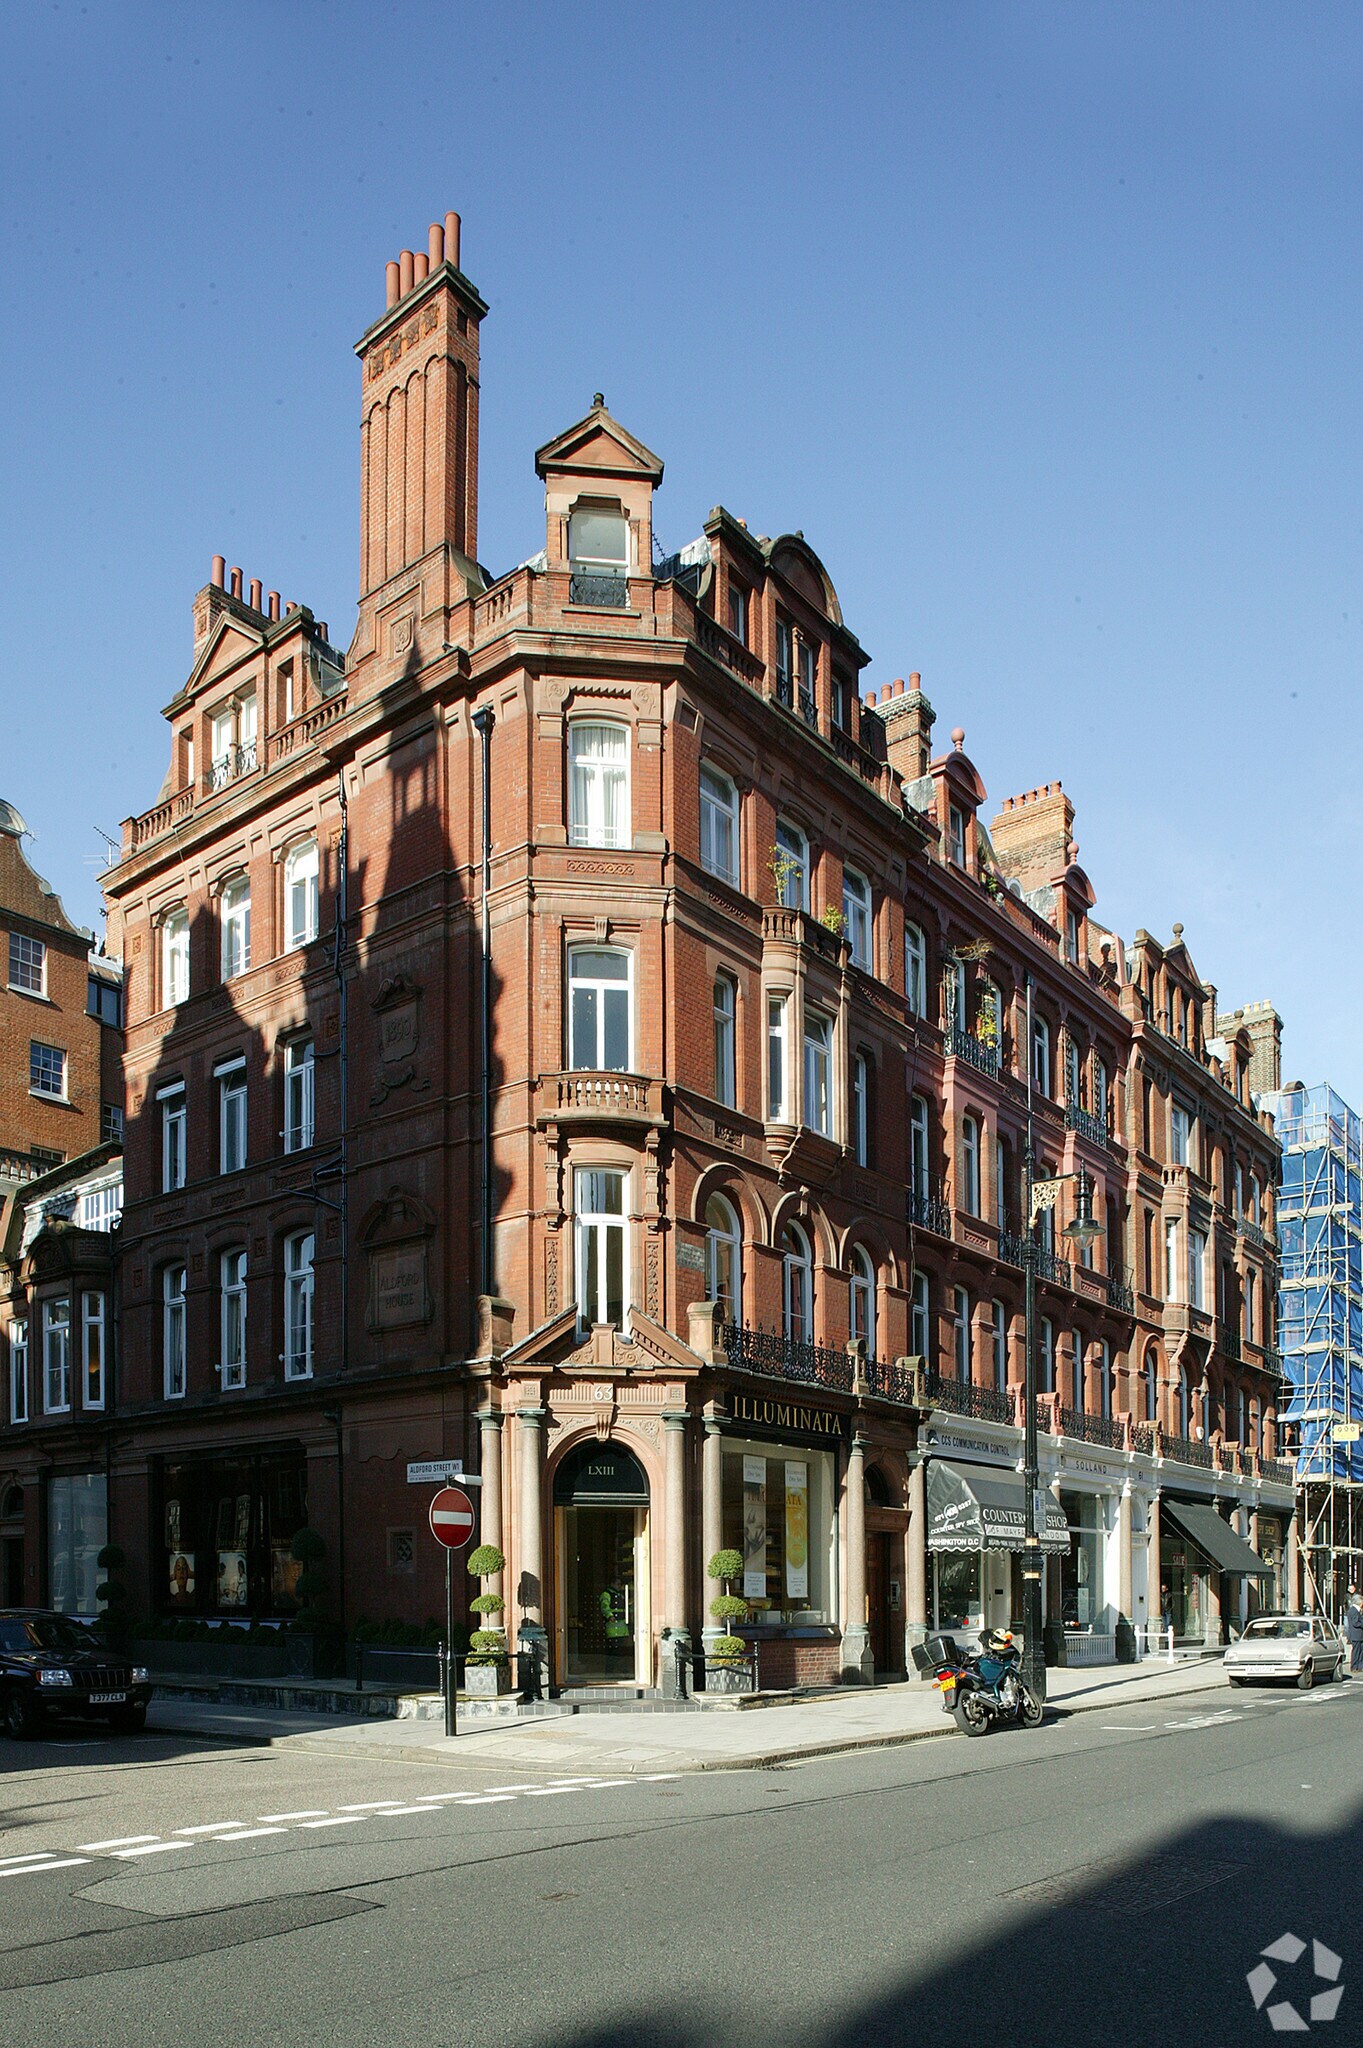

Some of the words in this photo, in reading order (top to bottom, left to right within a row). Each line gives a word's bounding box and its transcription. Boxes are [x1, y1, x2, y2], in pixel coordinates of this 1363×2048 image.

[380, 1273, 419, 1291] ALDFORD
[385, 1293, 414, 1309] HOUSE
[595, 1386, 612, 1401] 63
[733, 1396, 842, 1435] ILLUMINATA
[941, 1435, 951, 1446] CCS
[953, 1437, 989, 1452] COMMUNICATION
[990, 1443, 1010, 1456] CONTROL
[410, 1464, 432, 1473] ALDFORD
[433, 1463, 451, 1472] STREET
[452, 1462, 460, 1470] W1
[588, 1466, 614, 1475] LXIII
[1075, 1461, 1107, 1474] SOLLAND
[983, 1508, 1024, 1524] COUNTER
[1046, 1515, 1068, 1528] SHOP
[930, 1524, 955, 1535] COUNTER
[955, 1520, 965, 1529] SPY
[1003, 1527, 1025, 1536] MAYFA
[1040, 1531, 1065, 1540] ONDON
